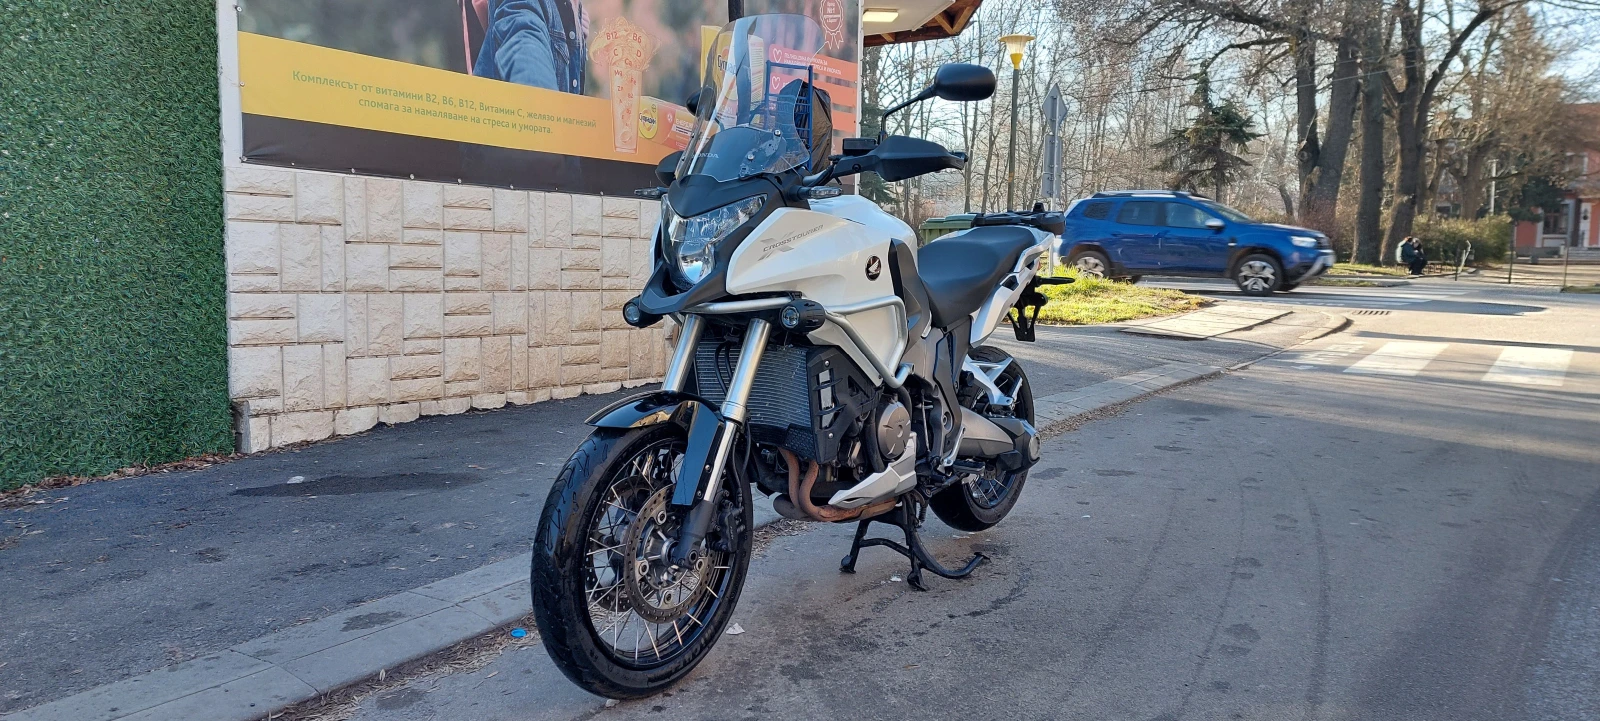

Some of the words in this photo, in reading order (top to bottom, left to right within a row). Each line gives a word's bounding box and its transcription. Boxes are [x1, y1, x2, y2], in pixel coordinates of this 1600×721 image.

[605, 31, 619, 40] B12
[632, 32, 642, 44] B6
[636, 49, 642, 58] D
[292, 70, 359, 91] Комплексът
[361, 84, 373, 93] от
[375, 86, 423, 101] витамини
[479, 102, 515, 116] Витамин
[526, 111, 555, 122] желязо
[556, 115, 561, 123] и
[562, 117, 597, 128] магнезий
[358, 98, 400, 112] спомага
[401, 105, 412, 114] за
[414, 107, 469, 122] намаляване
[470, 115, 481, 124] на
[482, 118, 510, 129] стреса
[511, 121, 517, 129] и
[518, 123, 553, 134] умората.
[762, 223, 825, 253] CROSSTOURER
